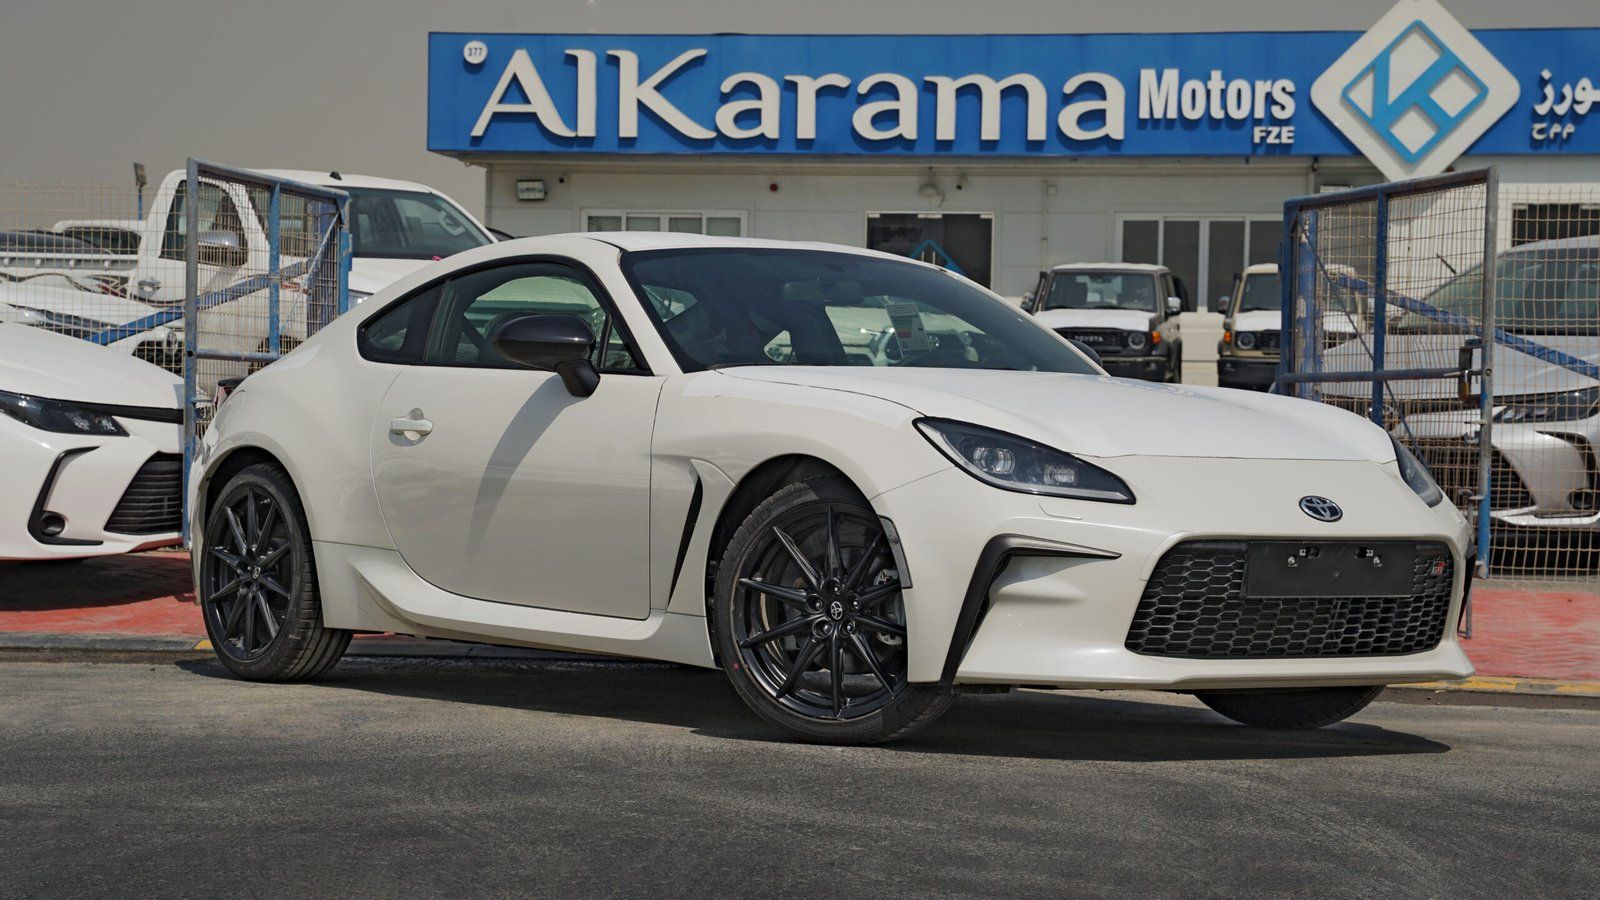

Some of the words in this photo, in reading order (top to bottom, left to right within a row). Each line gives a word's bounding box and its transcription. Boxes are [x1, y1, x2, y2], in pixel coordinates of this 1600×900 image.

[467, 47, 483, 57] 377
[1138, 67, 1296, 120] Motors
[1533, 68, 1600, 116] ورز
[1253, 126, 1295, 144] FZE
